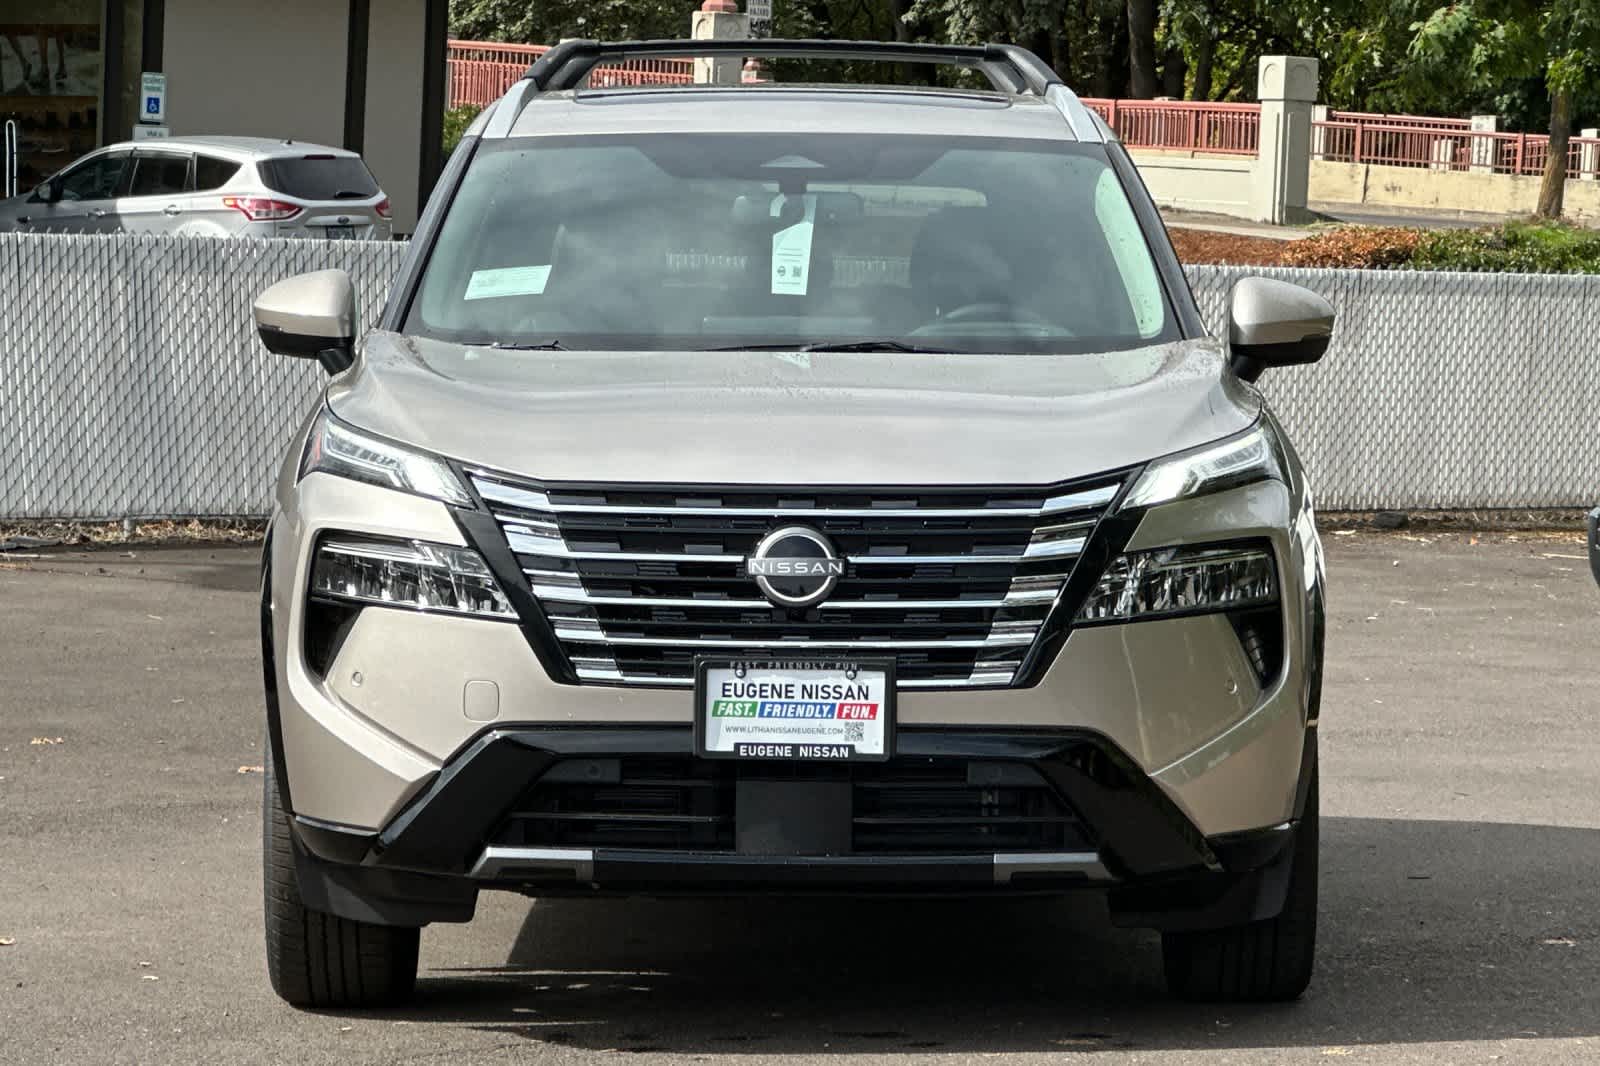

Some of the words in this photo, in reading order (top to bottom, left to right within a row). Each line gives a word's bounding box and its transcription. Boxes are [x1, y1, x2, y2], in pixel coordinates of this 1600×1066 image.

[751, 561, 843, 574] NISSAN
[721, 682, 795, 699] EUGENE
[801, 684, 869, 701] NISSAN
[717, 701, 754, 717] FAST.
[763, 703, 832, 718] FRIENDLY.
[841, 705, 874, 720] FUN.
[725, 724, 844, 736] WWW.LITHIANISSANEUGENE.COM
[739, 745, 792, 757] EUGENE
[799, 746, 849, 758] NISSAN
